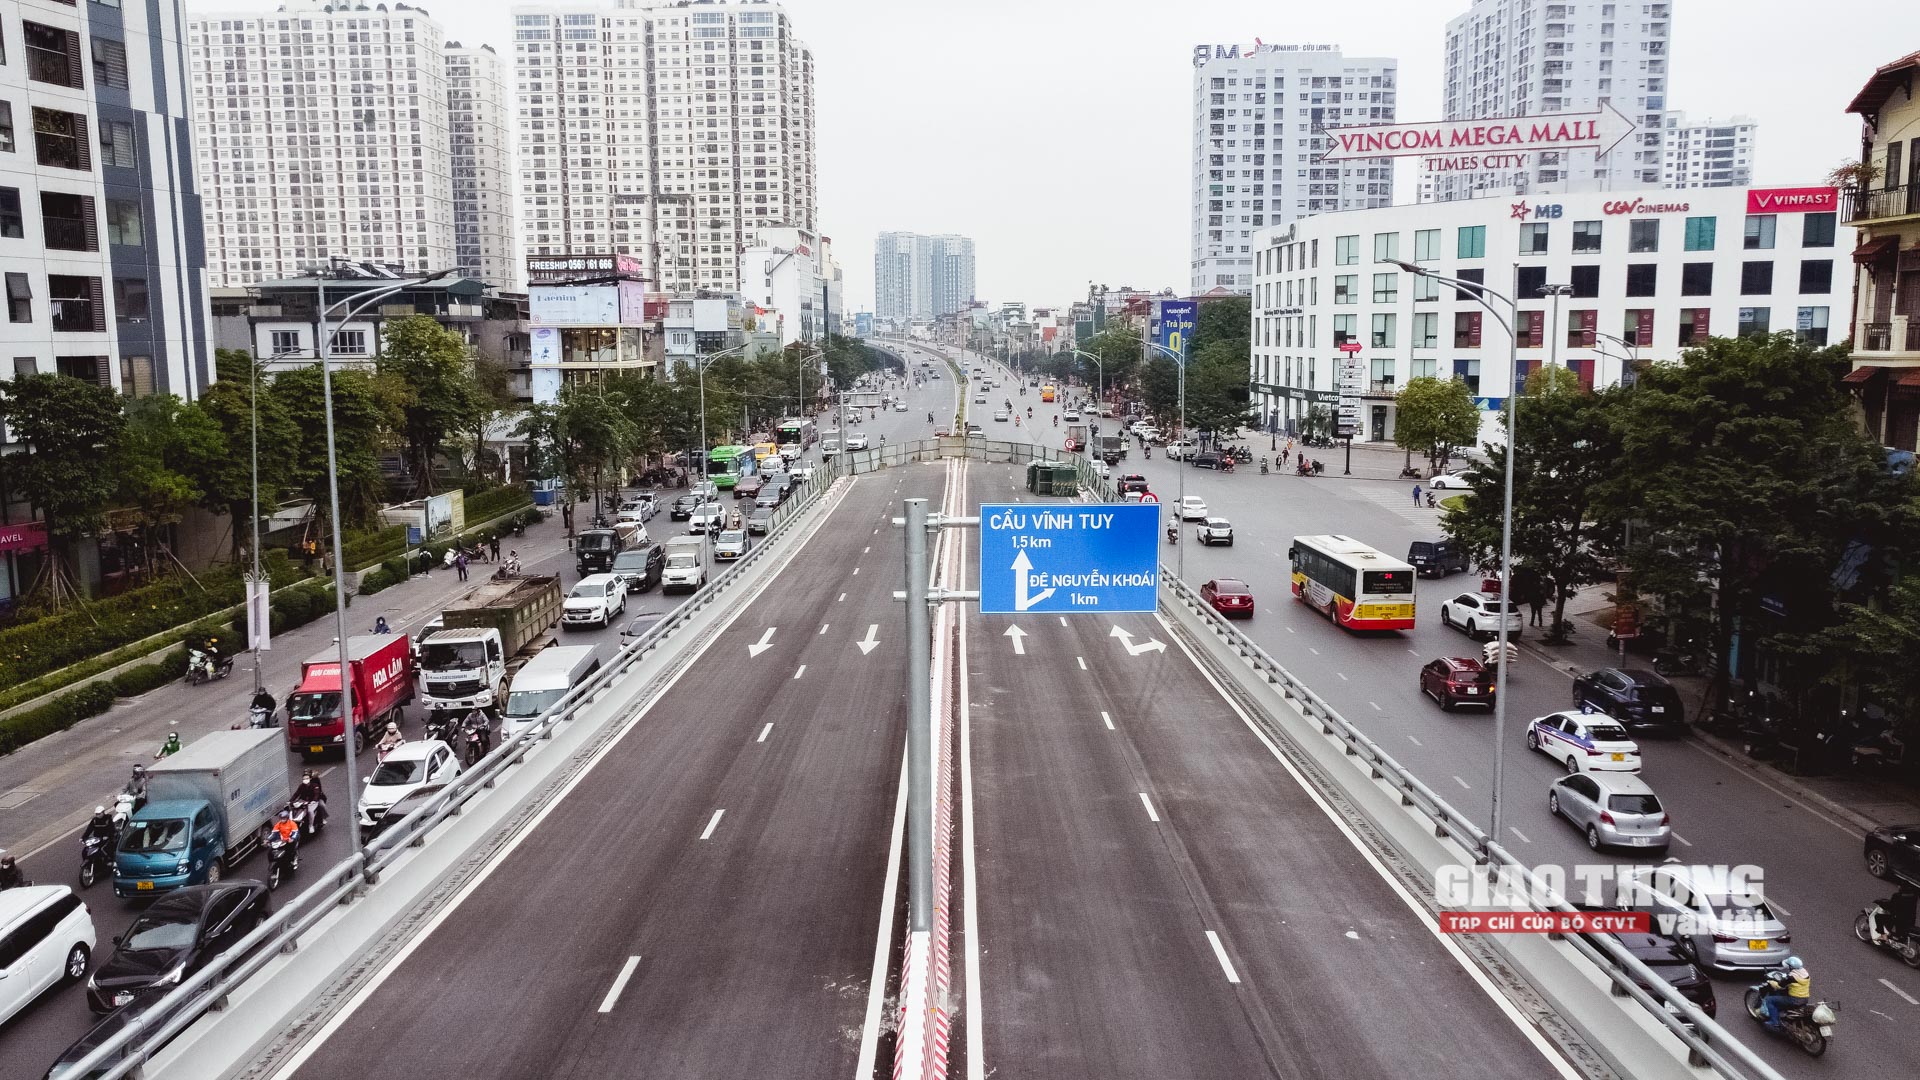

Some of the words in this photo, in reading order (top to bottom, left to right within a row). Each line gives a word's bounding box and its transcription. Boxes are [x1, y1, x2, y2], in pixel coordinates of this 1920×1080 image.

[1339, 129, 1443, 152] VINCOM
[1449, 125, 1525, 148] MEGA
[1528, 120, 1600, 143] MALL
[1425, 156, 1478, 172] TIMES
[1483, 153, 1526, 170] CITY
[1774, 194, 1832, 205] VINFAST
[1534, 204, 1563, 219] MB
[1603, 200, 1635, 216] CGV
[1637, 202, 1690, 214] CINEMAS
[530, 261, 568, 270] FREESHIP
[568, 259, 586, 269] 0569
[587, 259, 598, 269] 161
[599, 259, 613, 269] 666
[1166, 320, 1178, 328] Trả
[1180, 320, 1193, 330] góp
[990, 509, 1026, 530] CẦU
[1032, 511, 1073, 530] VĨNH
[1079, 514, 1114, 530] TUY
[0, 533, 23, 543] AVEL
[1011, 536, 1028, 549] 1,5
[1030, 536, 1051, 548] km
[1030, 572, 1049, 587] ĐÊ
[1052, 569, 1109, 587] NGUYỄN
[1112, 571, 1154, 587] KHOÁI
[372, 667, 387, 688] HOA
[387, 657, 403, 679] LÂM
